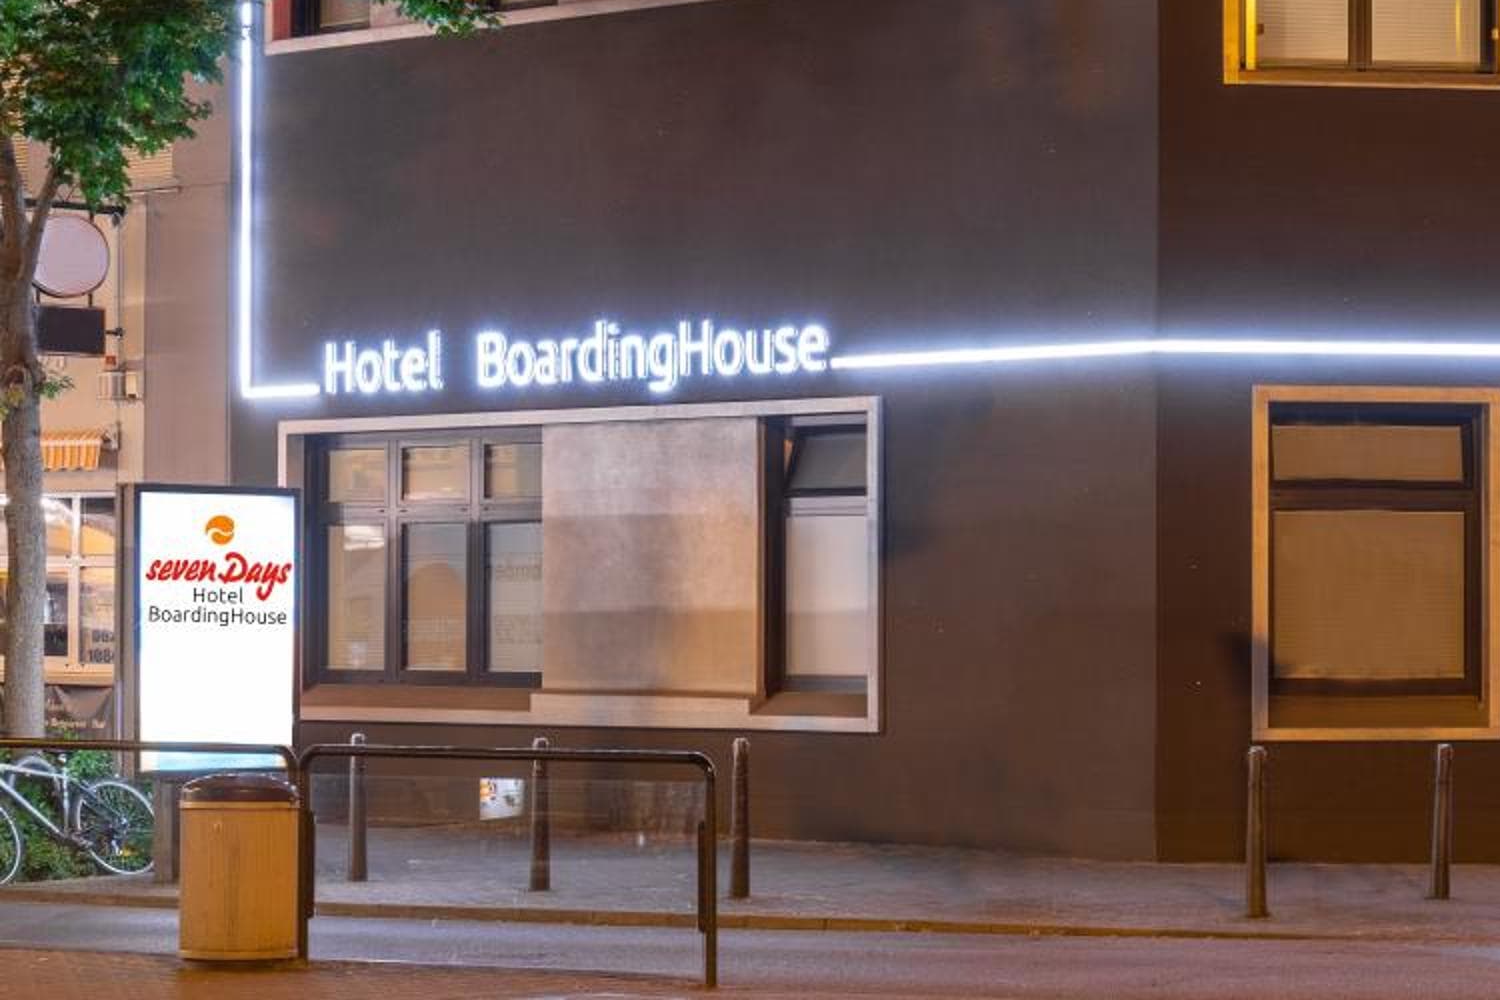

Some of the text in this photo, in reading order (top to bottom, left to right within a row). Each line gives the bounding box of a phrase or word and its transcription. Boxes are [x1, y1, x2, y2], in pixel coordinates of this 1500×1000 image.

[322, 318, 829, 394] Hotel BoardingHouse
[193, 586, 243, 604] Hotel
[149, 605, 287, 626] BoardingHouse
